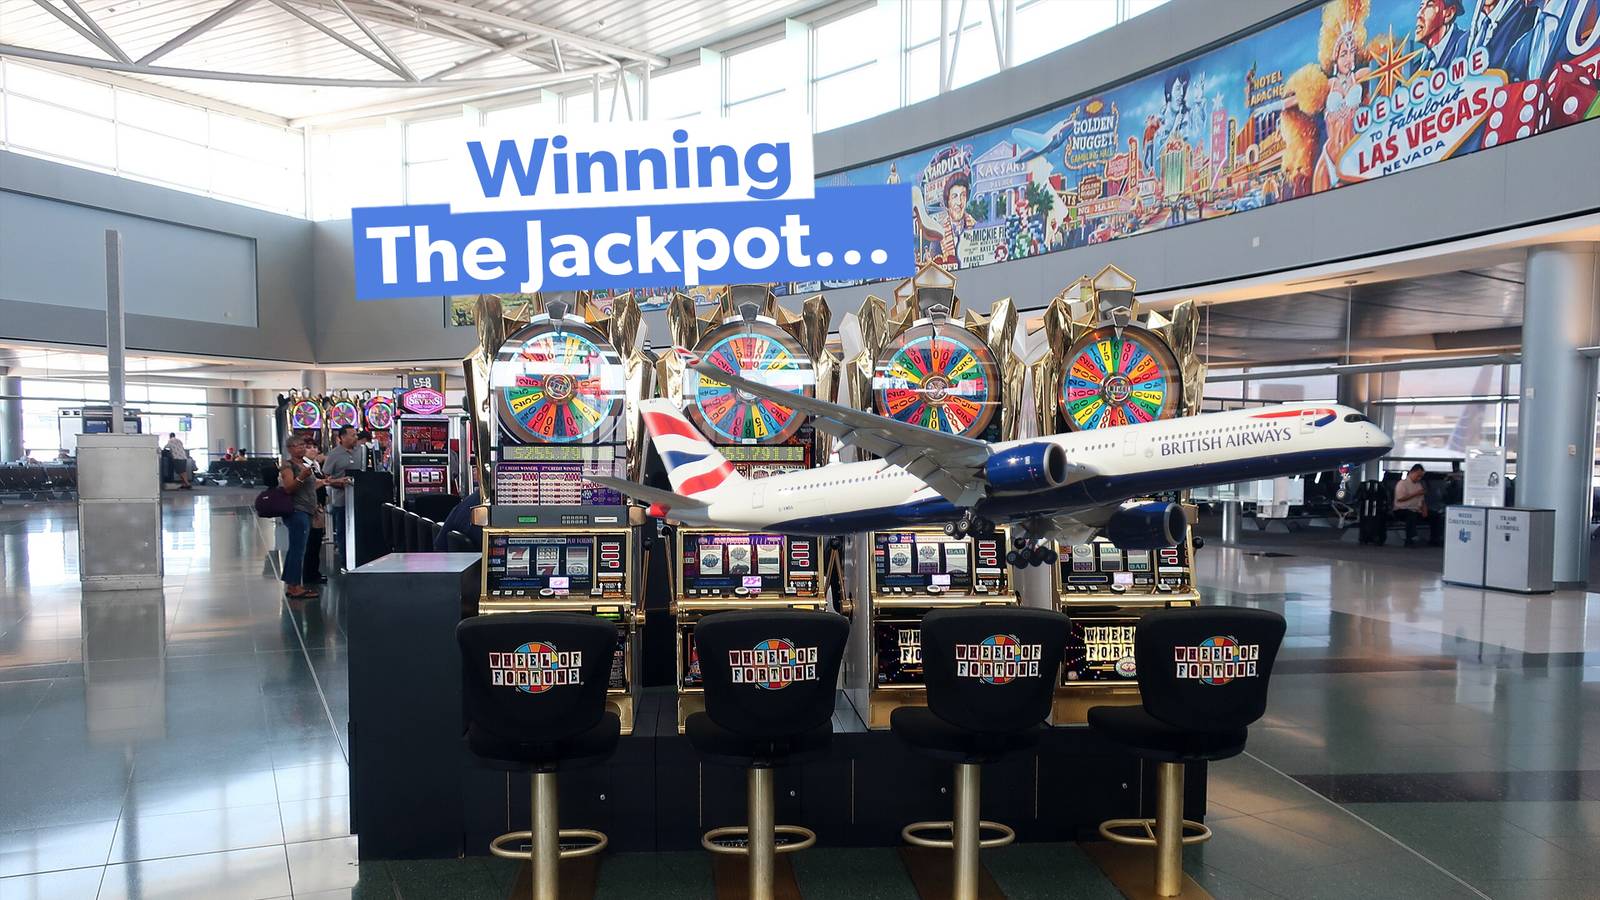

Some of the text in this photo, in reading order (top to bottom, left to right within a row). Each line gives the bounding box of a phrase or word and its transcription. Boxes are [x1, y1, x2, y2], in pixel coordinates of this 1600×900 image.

[1253, 70, 1283, 90] HOTEL
[1250, 83, 1286, 107] APACHE
[1355, 51, 1484, 129] WELCOME
[1370, 87, 1465, 142] TO Fabulous
[1073, 115, 1115, 134] GOLDEN
[1358, 87, 1488, 175] LAS VEGAS
[1071, 131, 1114, 151] NUGGET
[923, 144, 966, 184] STARDUST
[1382, 140, 1446, 176] NEVADA
[977, 160, 1026, 178] CAESARS
[971, 226, 998, 243] MICKIE
[1090, 347, 1107, 373] 100
[1101, 342, 1110, 361] 75
[1113, 341, 1120, 360] 60
[1122, 343, 1132, 362] 30
[1079, 356, 1095, 371] 25
[1072, 366, 1098, 382] 400
[1132, 369, 1158, 384] 100
[1068, 389, 1096, 397] 200
[1134, 390, 1161, 400] 250
[1070, 399, 1089, 411] 50
[1078, 401, 1100, 422] 100
[1100, 408, 1111, 429] 000
[1161, 427, 1292, 456] BRITISH AIRWAYS
[1084, 626, 1137, 644] WHEE
[489, 651, 582, 669] WHEEL OF
[728, 646, 818, 667] WHEEL OF
[955, 643, 1042, 661] WHEEL OF
[1085, 643, 1135, 662] FORT
[1174, 644, 1259, 663] WHEEL OF
[491, 668, 580, 686] FORTUNE
[732, 663, 816, 684] FORTUNE
[957, 660, 1039, 678] FORTUNE
[1176, 661, 1257, 679] FORTUNE
